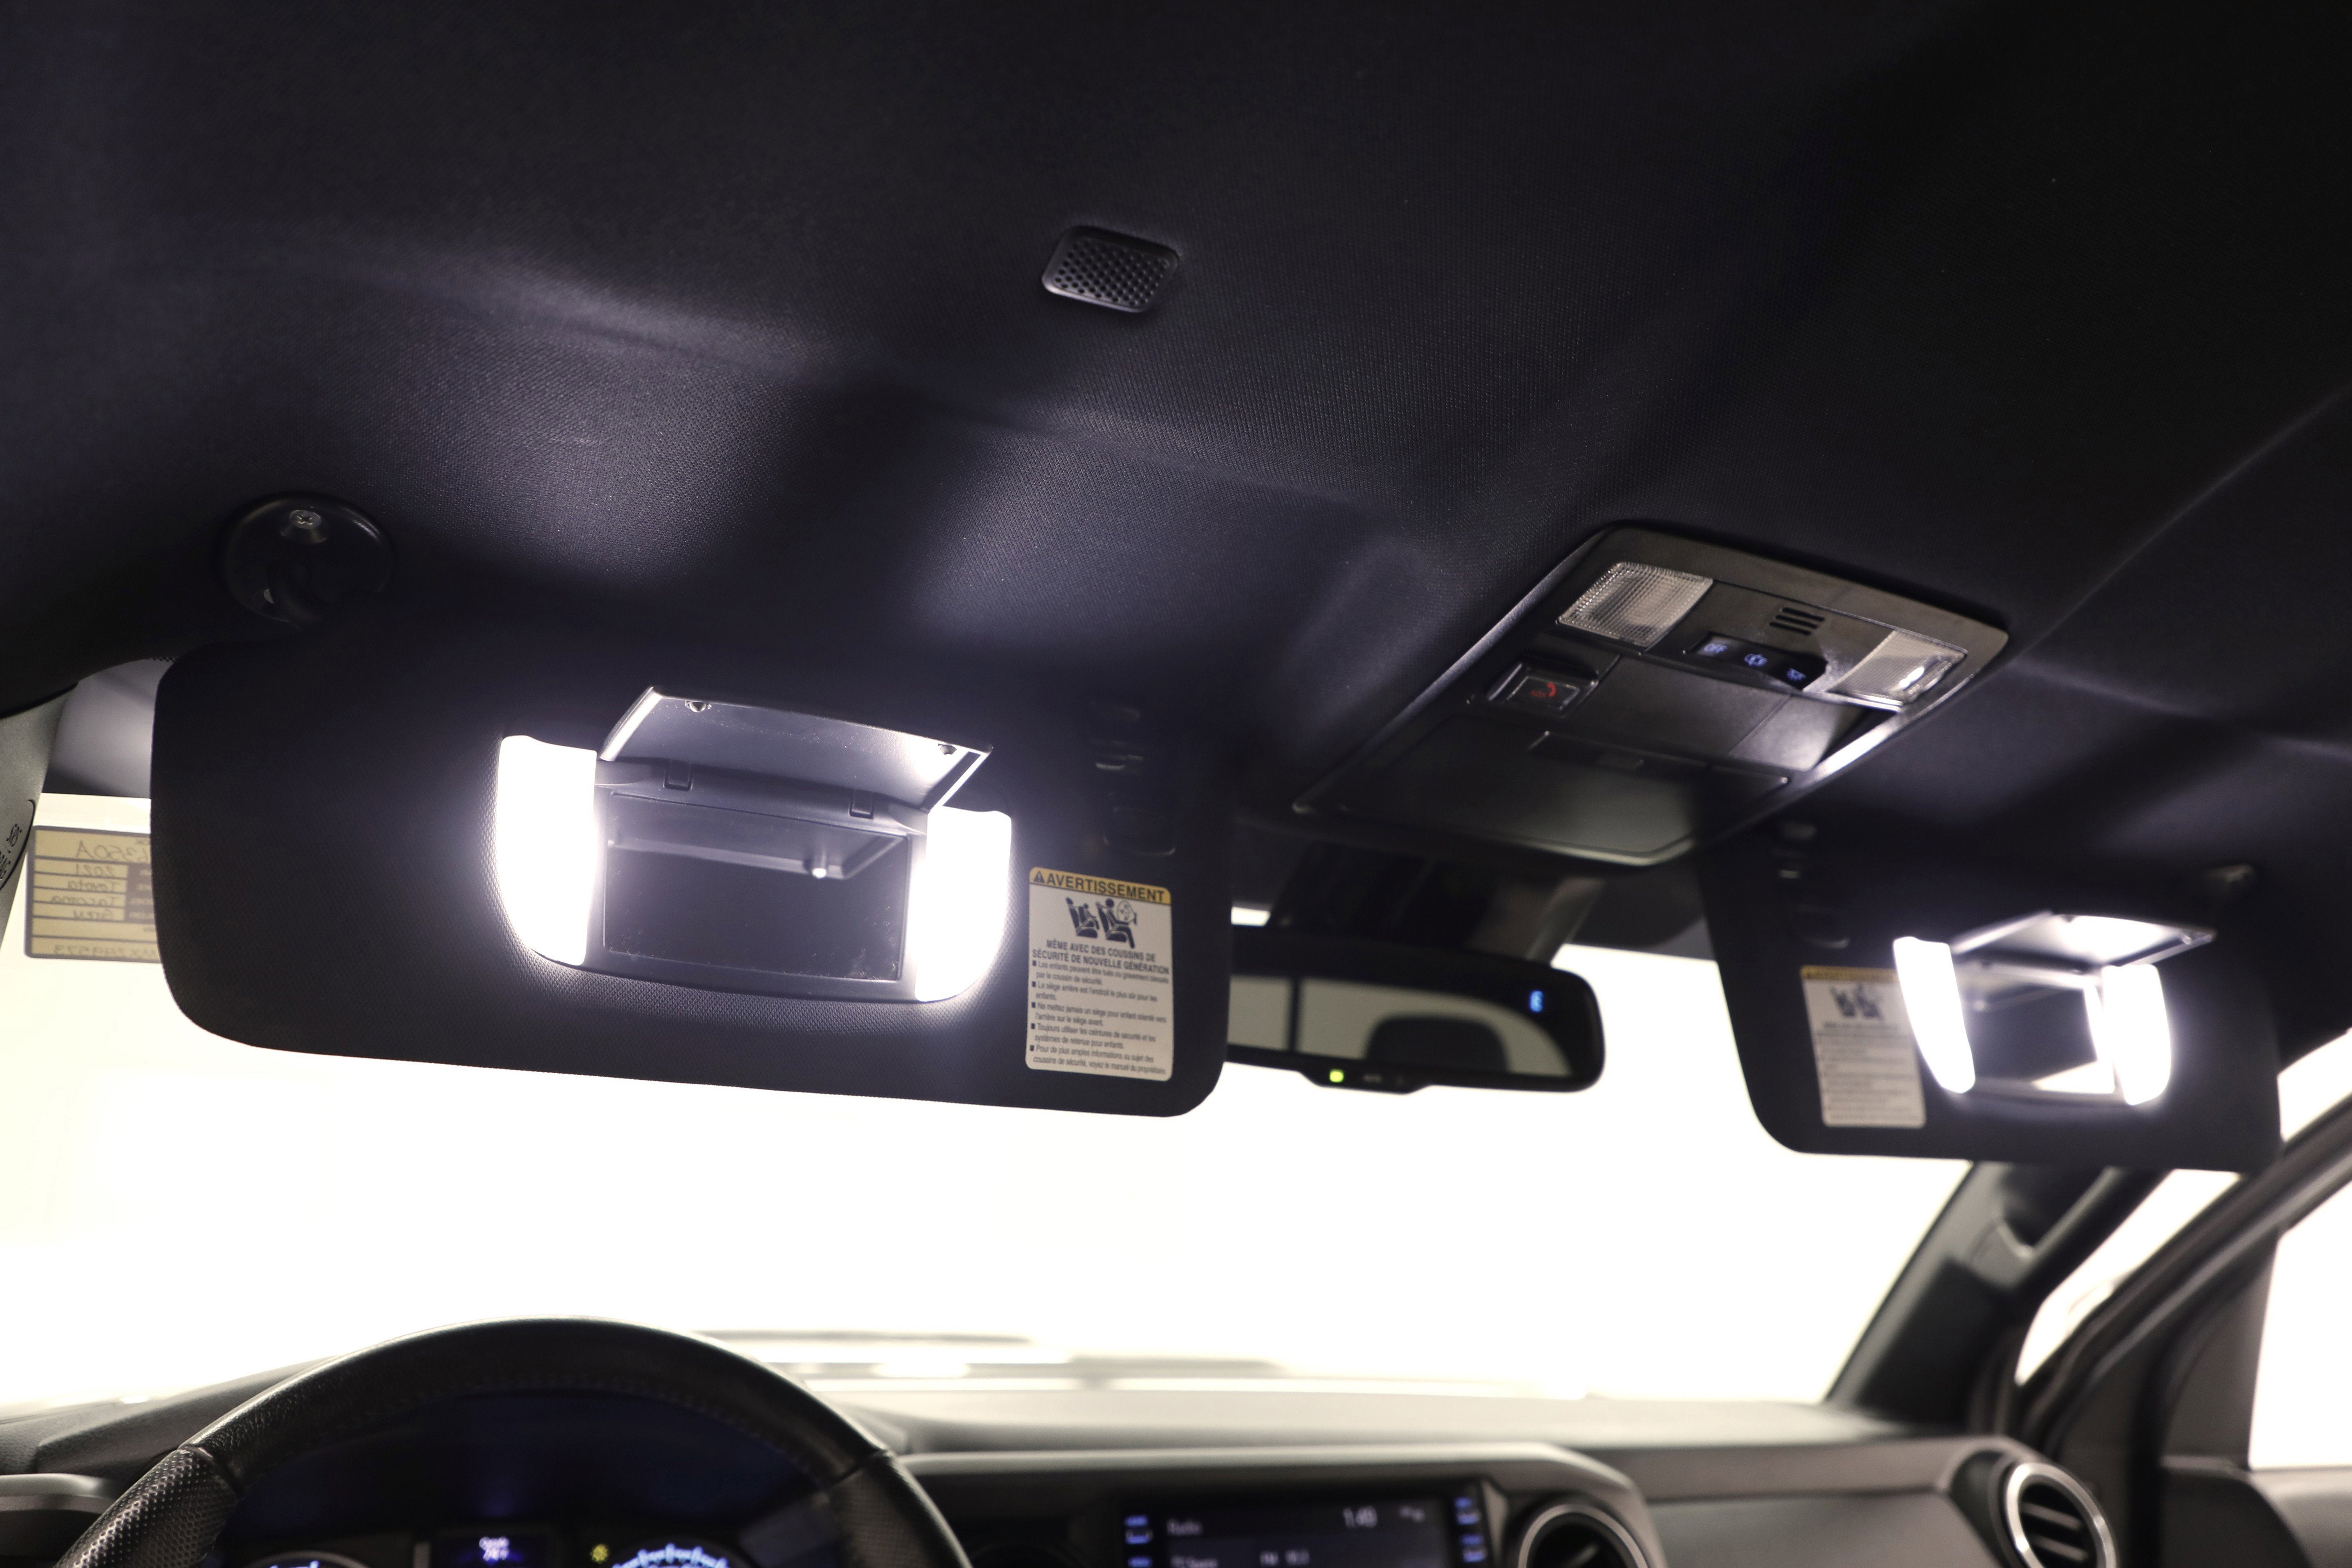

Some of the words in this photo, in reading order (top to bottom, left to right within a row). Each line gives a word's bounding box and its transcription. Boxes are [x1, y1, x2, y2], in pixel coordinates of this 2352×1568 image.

[1047, 873, 1164, 902] AVERTISSEMENT
[1032, 948, 1069, 961] SÉCURITÉ
[1071, 954, 1081, 963] DE
[1083, 955, 1120, 968] NOUVELLE
[1046, 939, 1068, 950] MÊME
[1070, 942, 1089, 953] AVEC
[1091, 945, 1105, 955] DES
[1108, 948, 1143, 960] COUSSINS
[1146, 953, 1154, 962] DE
